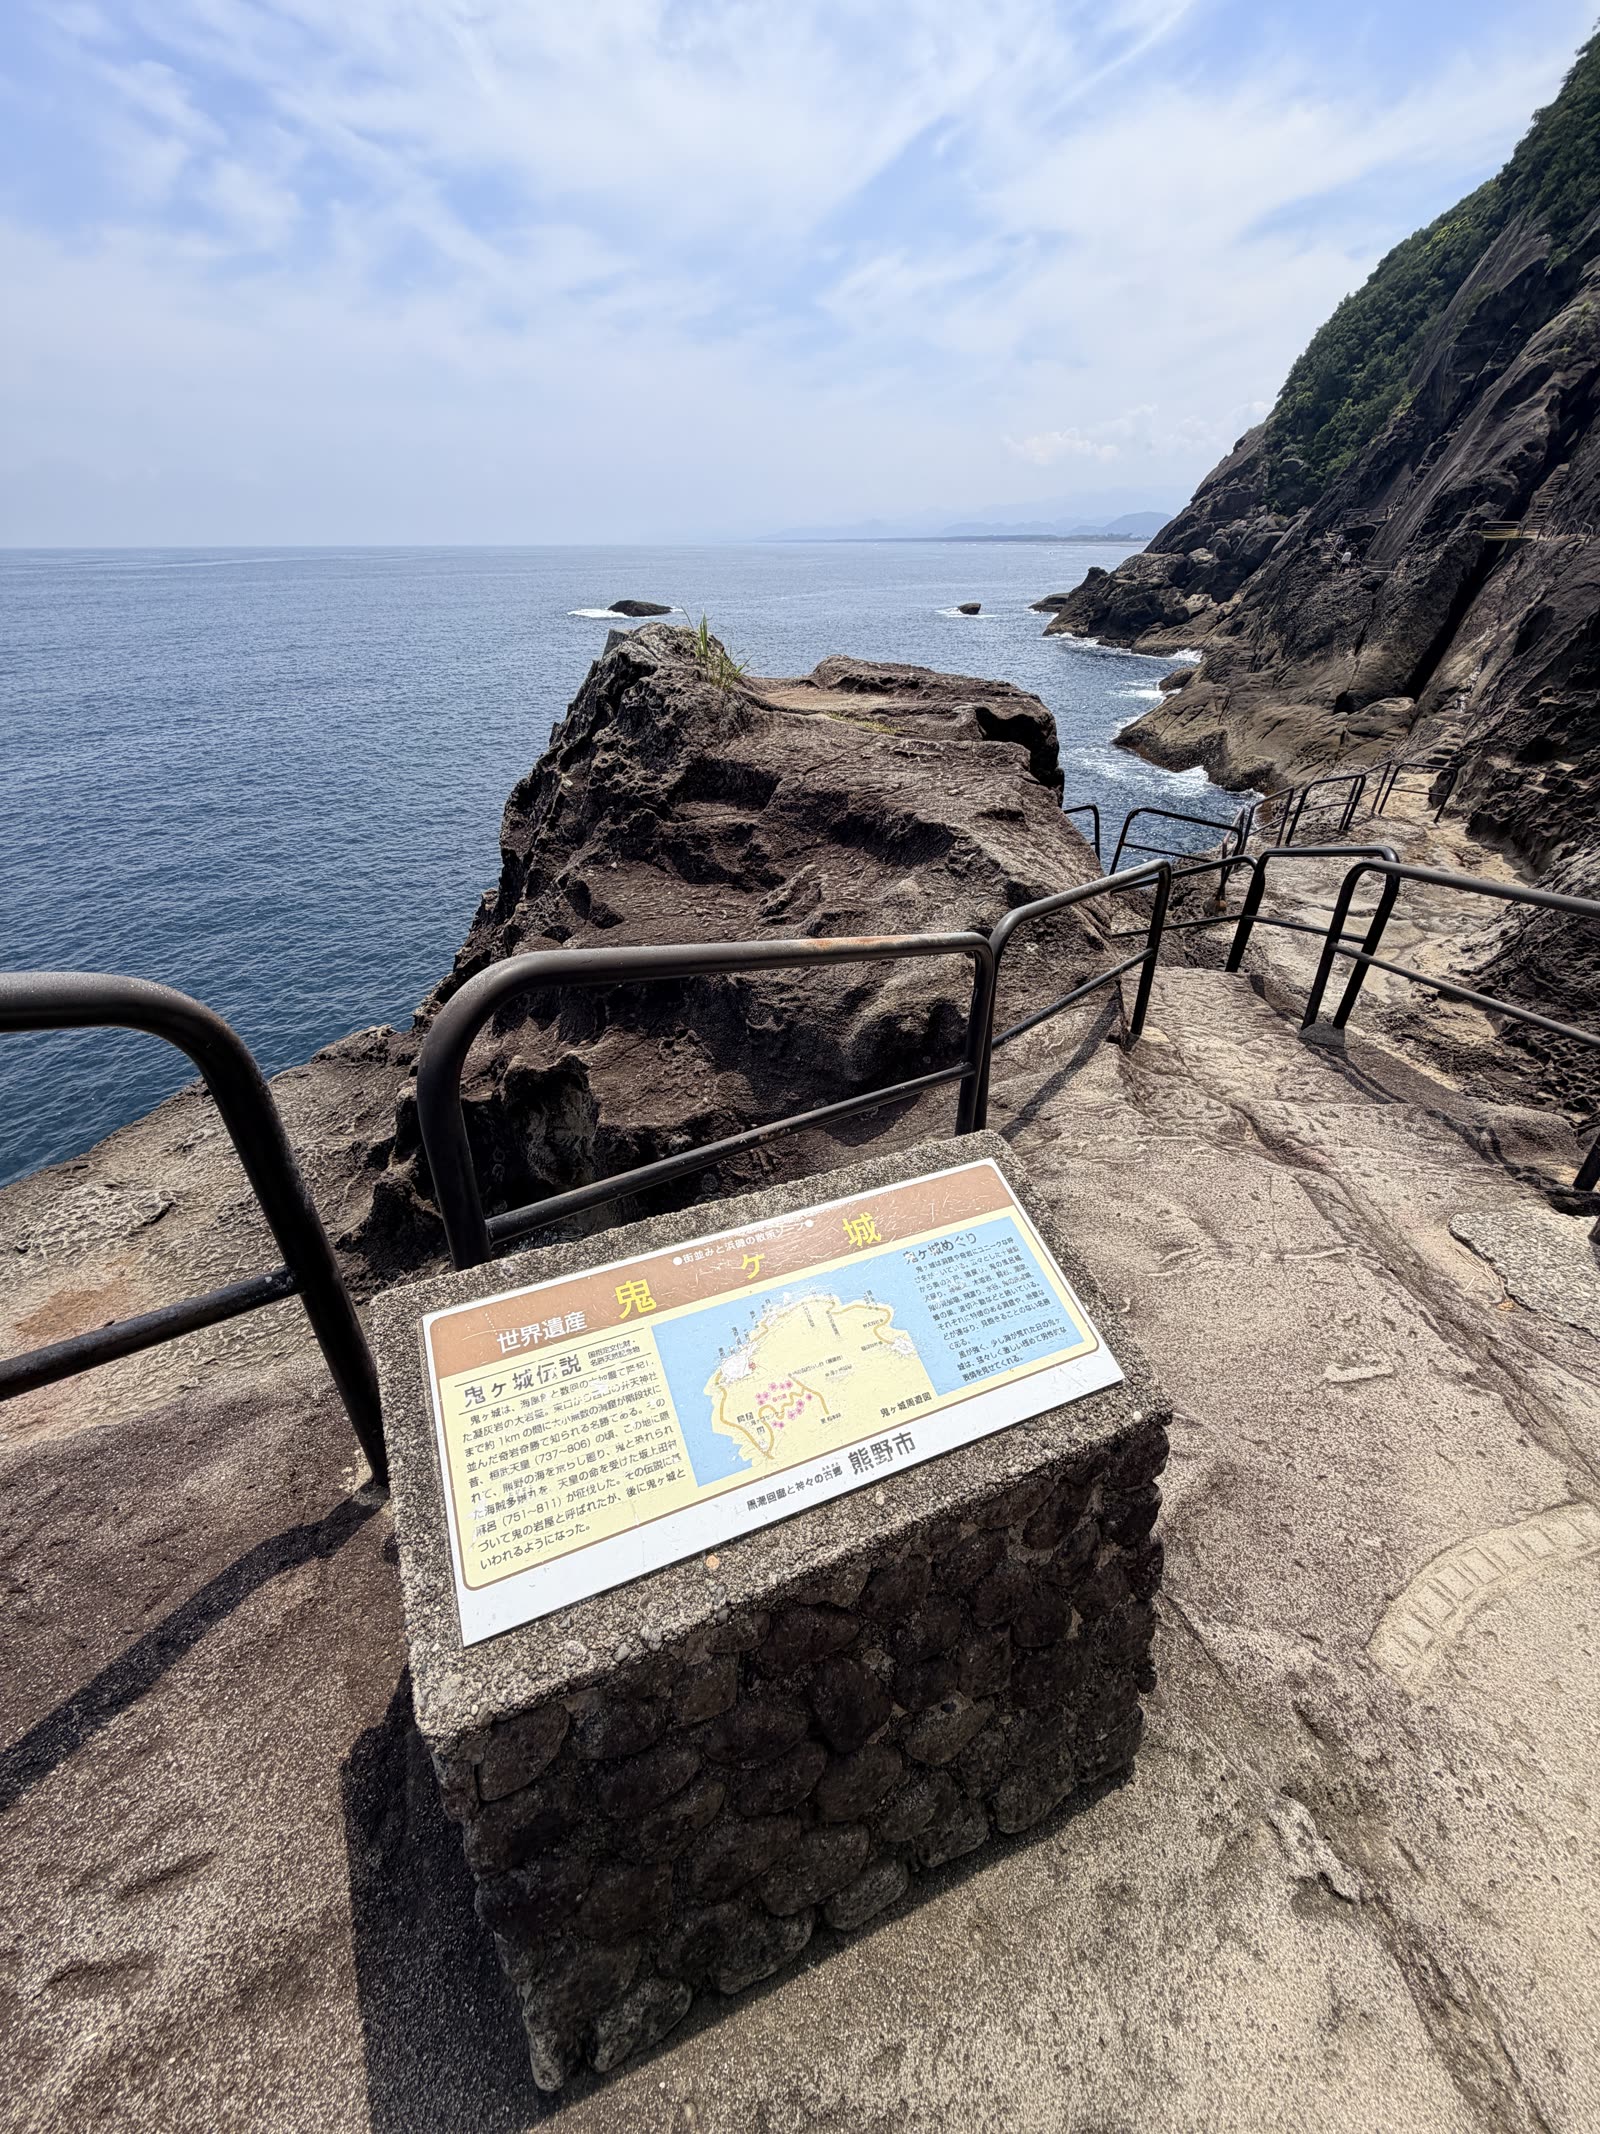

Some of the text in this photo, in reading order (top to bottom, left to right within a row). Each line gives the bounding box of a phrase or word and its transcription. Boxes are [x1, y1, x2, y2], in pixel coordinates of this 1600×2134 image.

[496, 1308, 587, 1354] 世界遺産
[846, 1429, 918, 1475] 熊野市
[480, 1519, 591, 1570] いわれるようになった。
